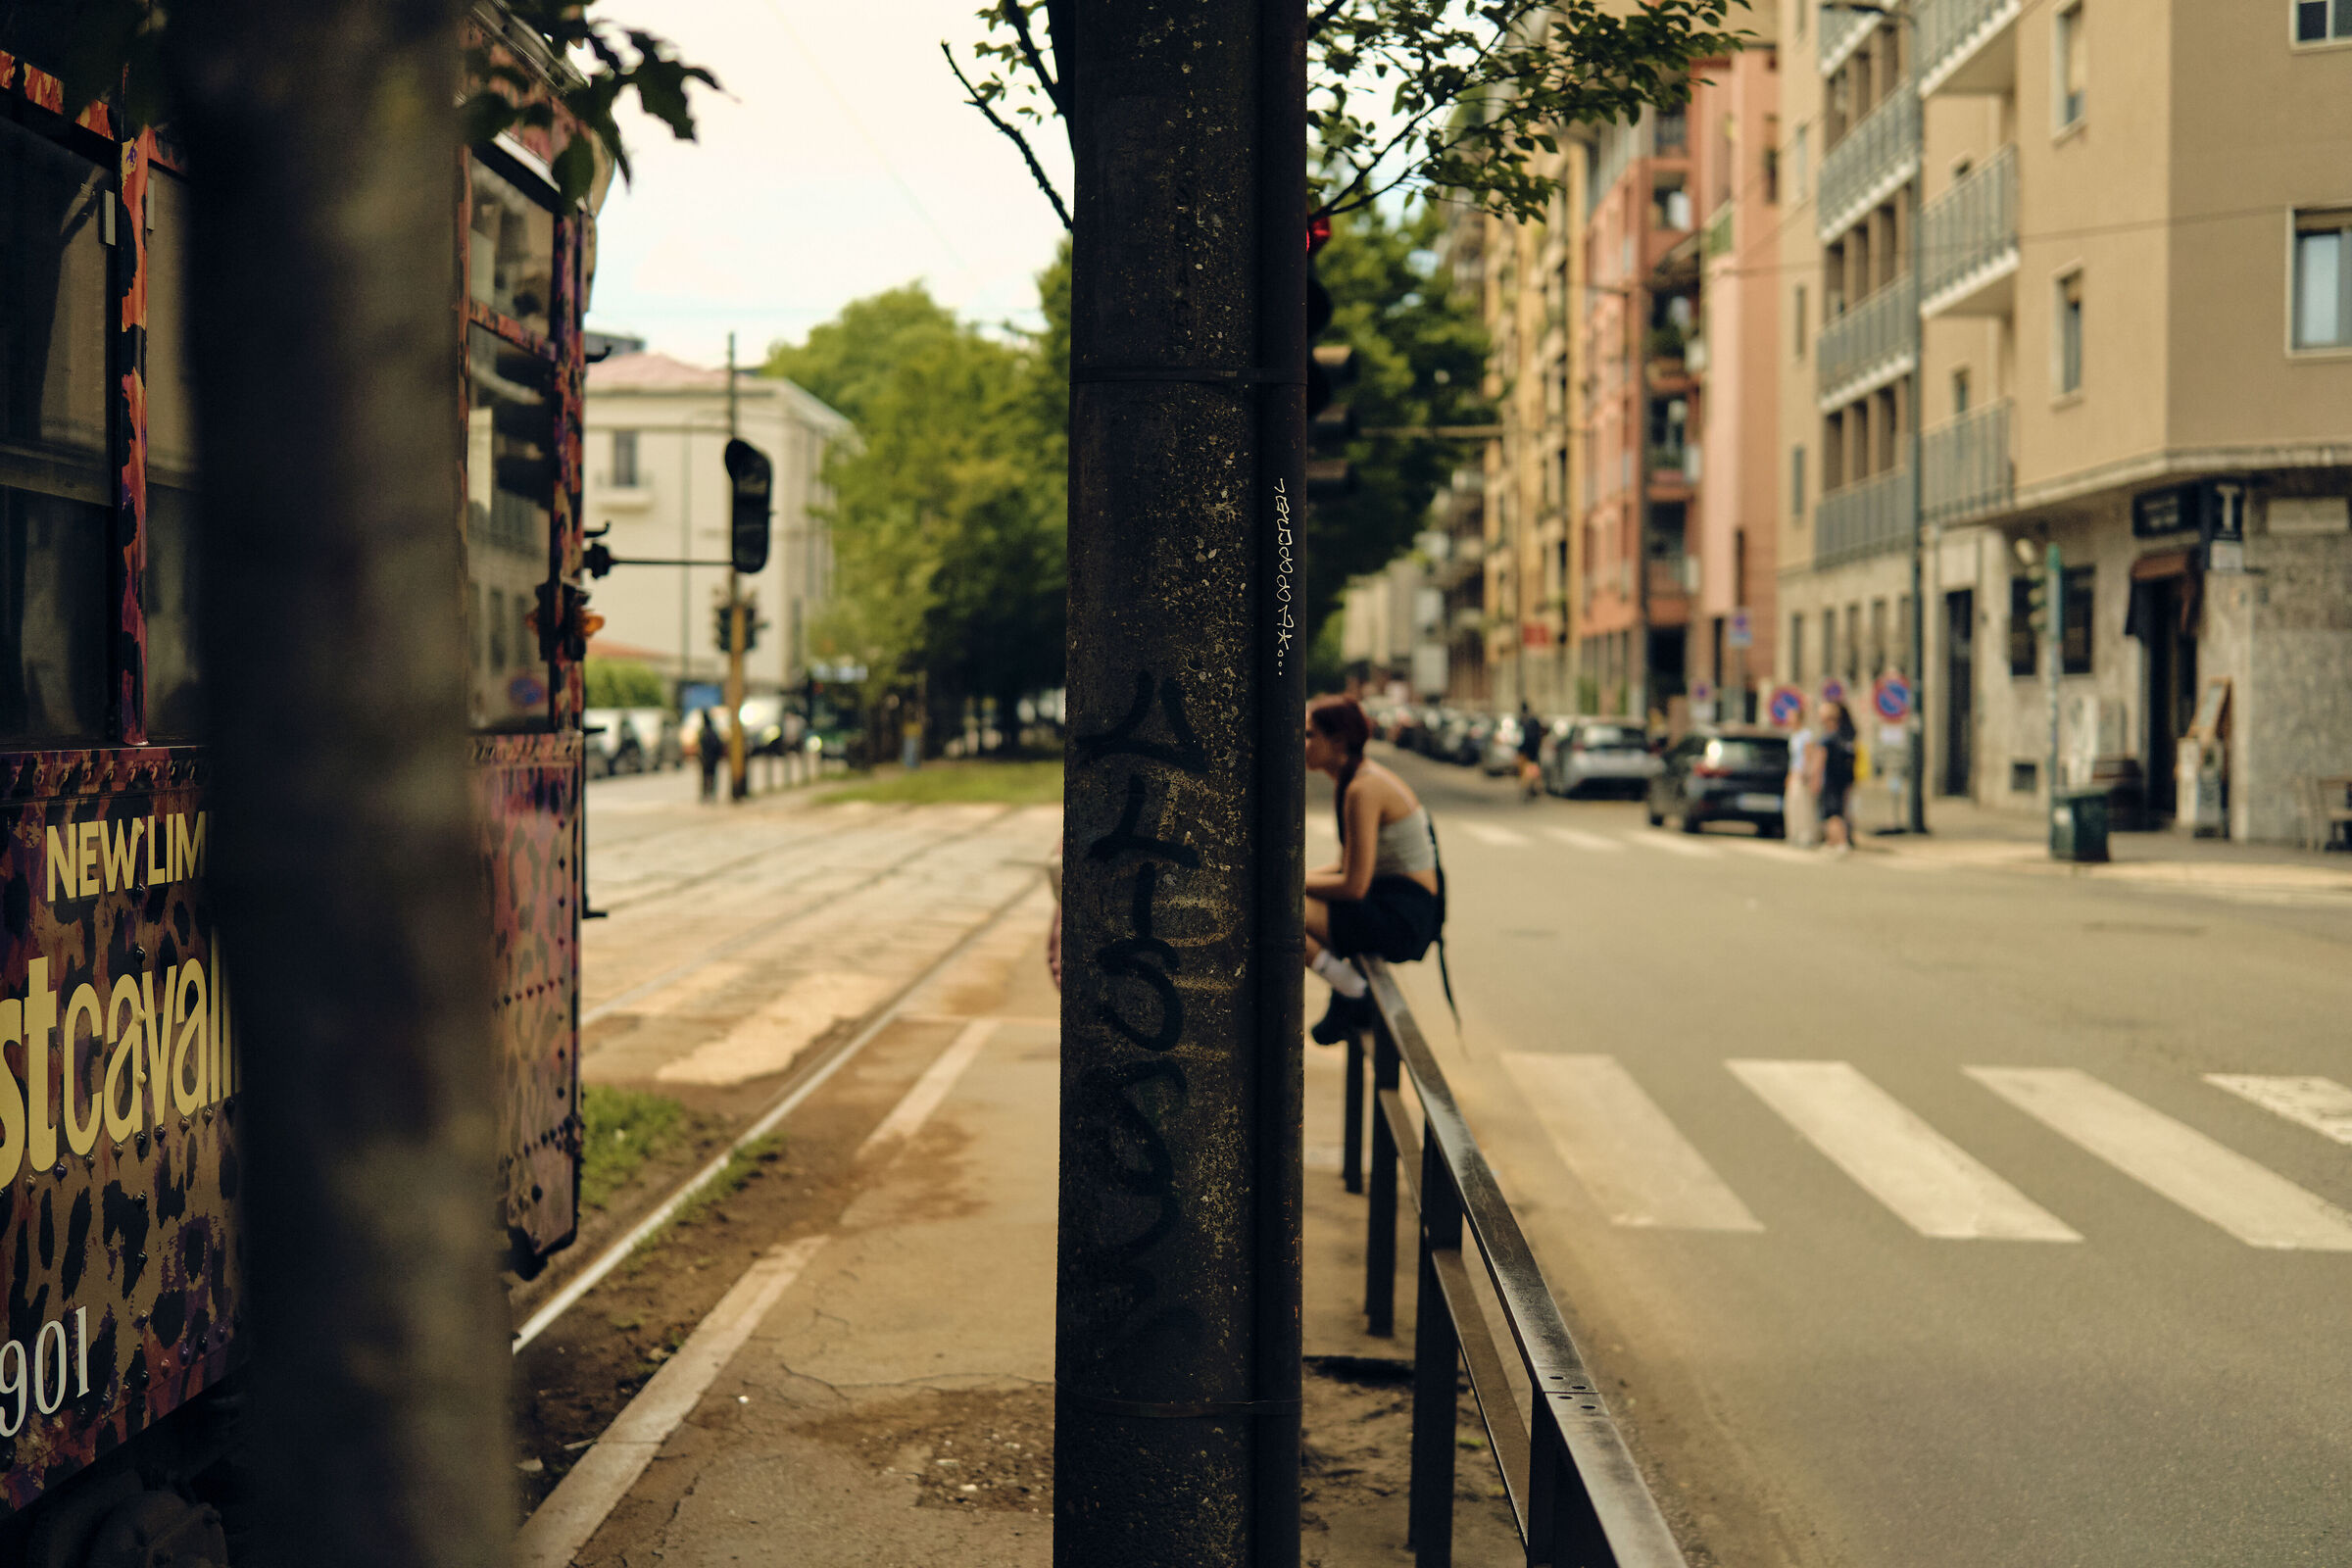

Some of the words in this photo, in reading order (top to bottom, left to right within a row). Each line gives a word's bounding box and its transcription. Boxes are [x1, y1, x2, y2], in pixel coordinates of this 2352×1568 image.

[47, 817, 144, 903] NEW
[148, 810, 210, 886] LIM
[0, 1305, 90, 1438] 901
